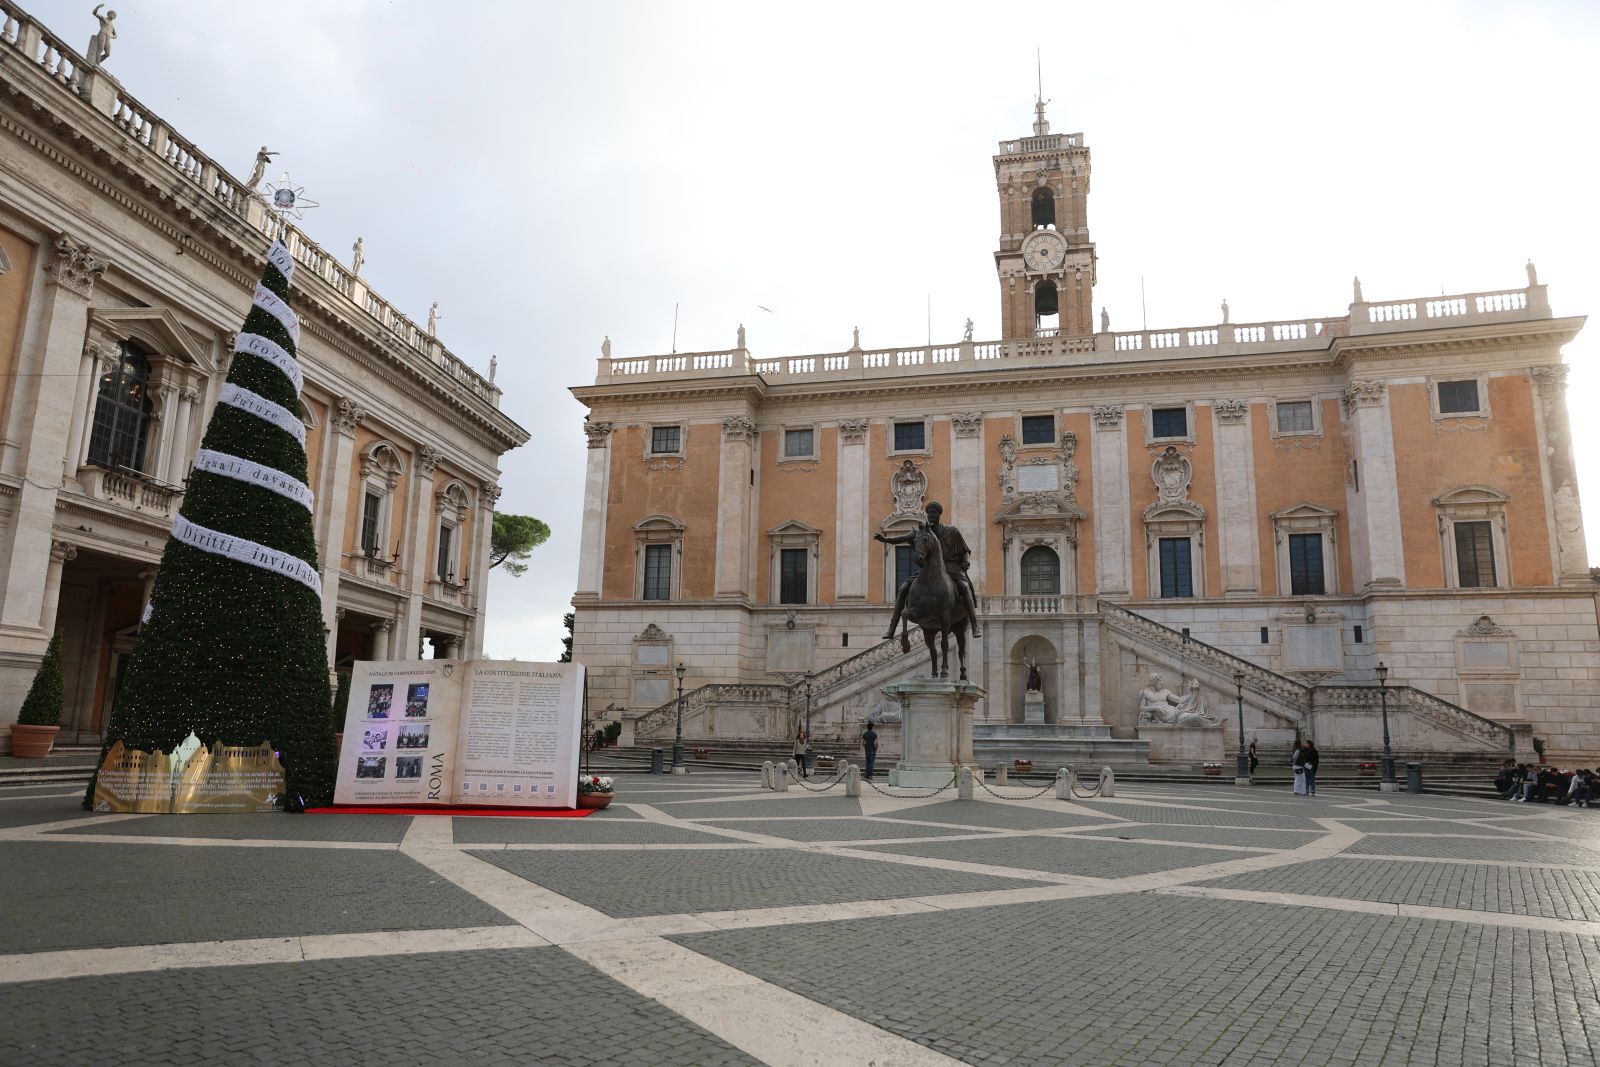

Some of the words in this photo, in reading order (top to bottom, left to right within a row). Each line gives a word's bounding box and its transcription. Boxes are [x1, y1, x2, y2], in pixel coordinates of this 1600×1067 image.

[232, 392, 279, 420] Future
[201, 454, 242, 475] Eguali
[252, 469, 305, 498] davanti
[183, 524, 234, 553] Diritti
[484, 670, 531, 678] COSTITUZIONE
[428, 752, 445, 800] ROMA
